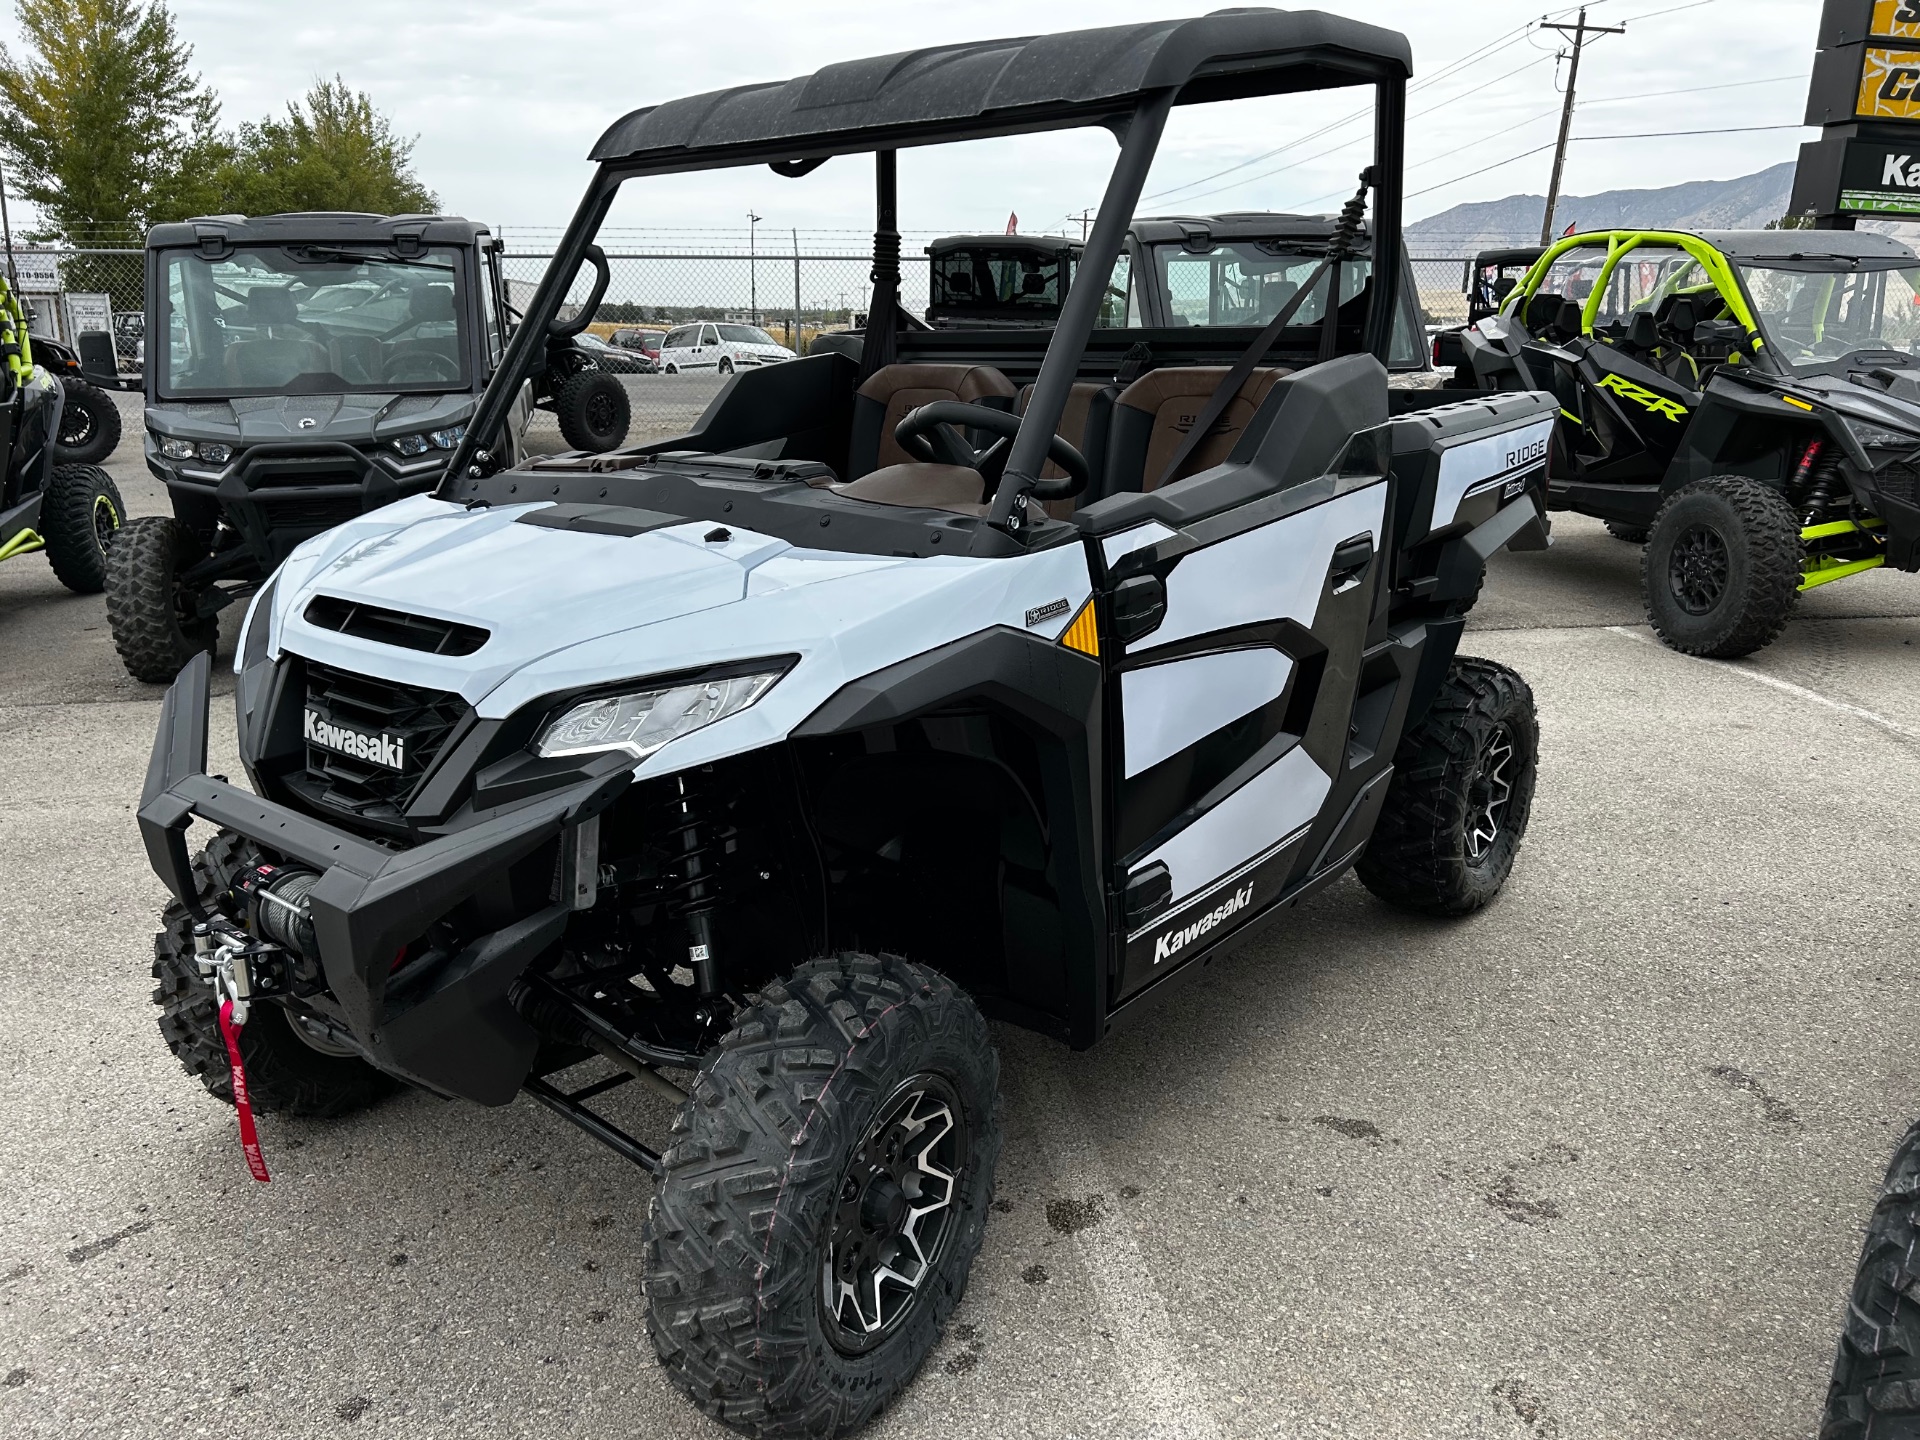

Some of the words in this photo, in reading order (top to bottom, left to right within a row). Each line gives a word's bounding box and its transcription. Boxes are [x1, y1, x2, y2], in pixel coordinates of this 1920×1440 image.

[1878, 67, 1920, 102] C
[1594, 372, 1689, 423] RZR
[1506, 439, 1545, 468] RIDGE
[1040, 601, 1067, 614] RIDGE
[304, 708, 404, 770] Kawasaki
[1153, 880, 1254, 965] Kawasaki
[232, 1065, 248, 1105] WARN
[244, 1143, 267, 1178] WARN
